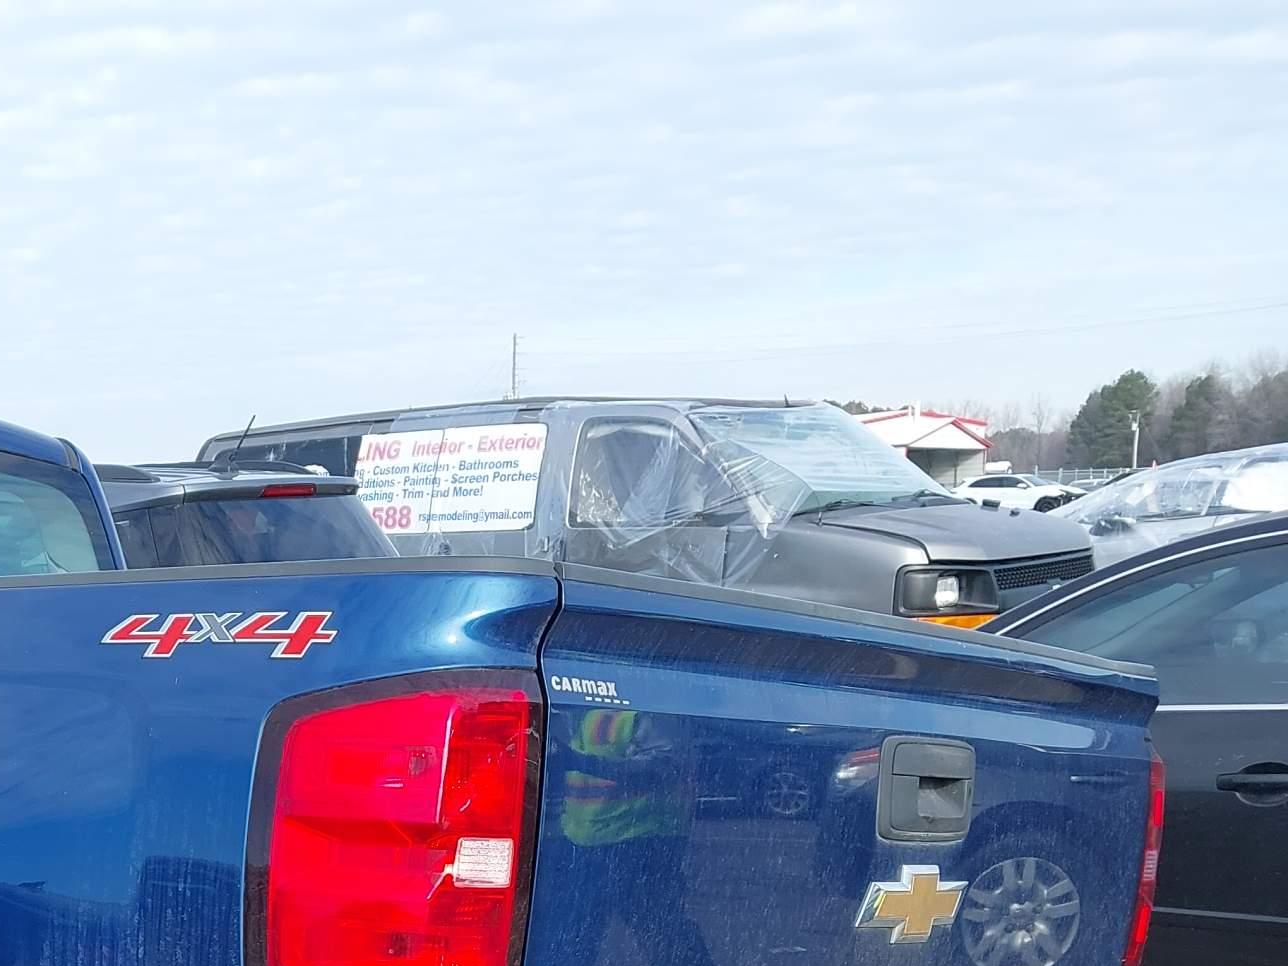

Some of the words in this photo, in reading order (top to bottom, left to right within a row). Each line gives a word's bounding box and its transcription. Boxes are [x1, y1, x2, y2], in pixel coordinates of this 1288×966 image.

[477, 433, 543, 453] Exterior
[373, 465, 409, 476] Custom
[458, 459, 519, 471] Bathrooms
[450, 473, 489, 484] Screen
[492, 470, 538, 483] Porches
[452, 484, 484, 497] More!
